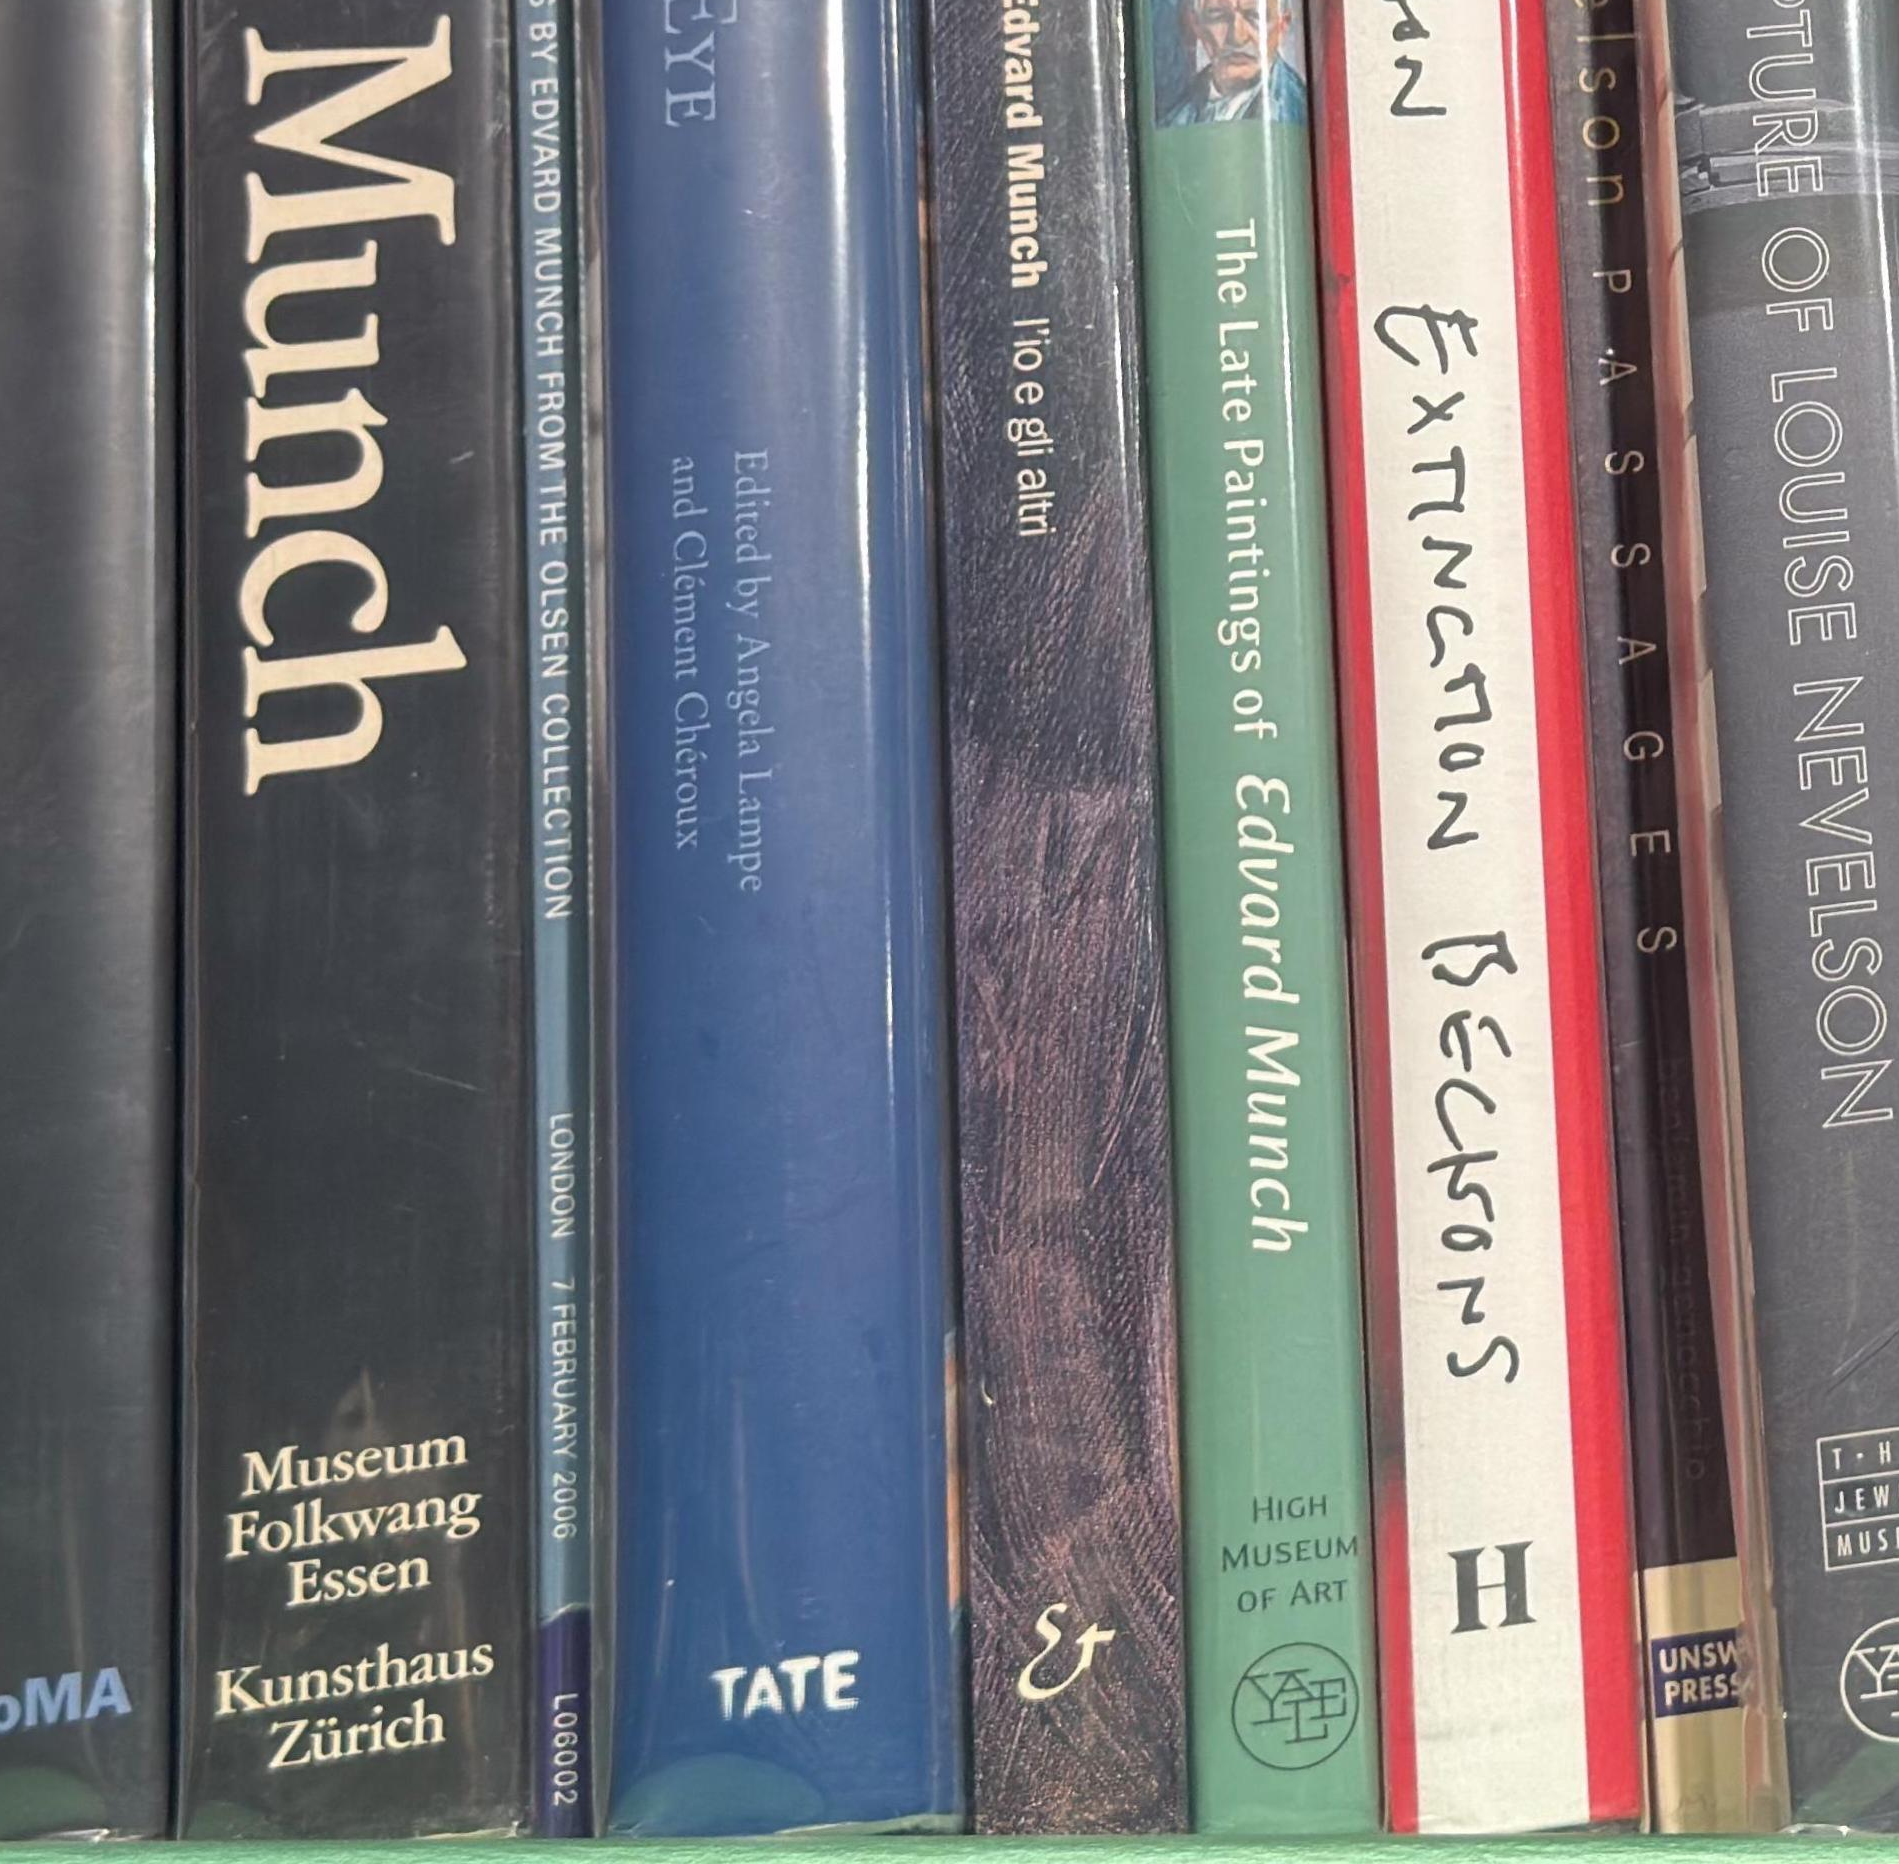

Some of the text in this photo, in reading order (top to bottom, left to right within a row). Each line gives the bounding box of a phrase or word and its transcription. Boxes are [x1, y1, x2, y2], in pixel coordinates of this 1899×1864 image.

[530, 20, 558, 64] BY
[531, 80, 561, 214] EDVARD
[1007, 143, 1048, 288] Munch
[534, 227, 565, 360] MUNCH
[1761, 227, 1834, 333] OF
[239, 14, 467, 795] Munch
[537, 372, 567, 471] FROM
[1007, 417, 1054, 458] gli
[1014, 382, 1044, 405] e
[540, 475, 567, 545] THE
[1017, 469, 1055, 537] altri
[1771, 366, 1858, 647] LOUISE
[540, 561, 570, 681] OLSEN
[1372, 302, 1493, 852] EXTINCTION
[671, 457, 711, 850] and Clément Chéroux
[725, 449, 775, 892] Edited by Angela Lampe
[1215, 218, 1309, 1253] The Late Paintings of Edvard Munch
[542, 693, 572, 920] COLLECTION
[1794, 676, 1894, 1131] NEVELSON
[1421, 930, 1520, 1384] BECKONS
[550, 1112, 579, 1540] LONDON 7 FEBRUARY 2006
[241, 1432, 468, 1498] Museum
[226, 1489, 481, 1558] Folkwang
[286, 1552, 431, 1609] Essen
[1447, 1540, 1537, 1634] H
[215, 1639, 495, 1717] Kunsthaus
[711, 1650, 860, 1721] TATE
[1659, 1640, 1737, 1674] UNSW
[1665, 1672, 1740, 1706] PRESS
[269, 1703, 444, 1771] Zürich
[552, 1692, 580, 1806] L06002
